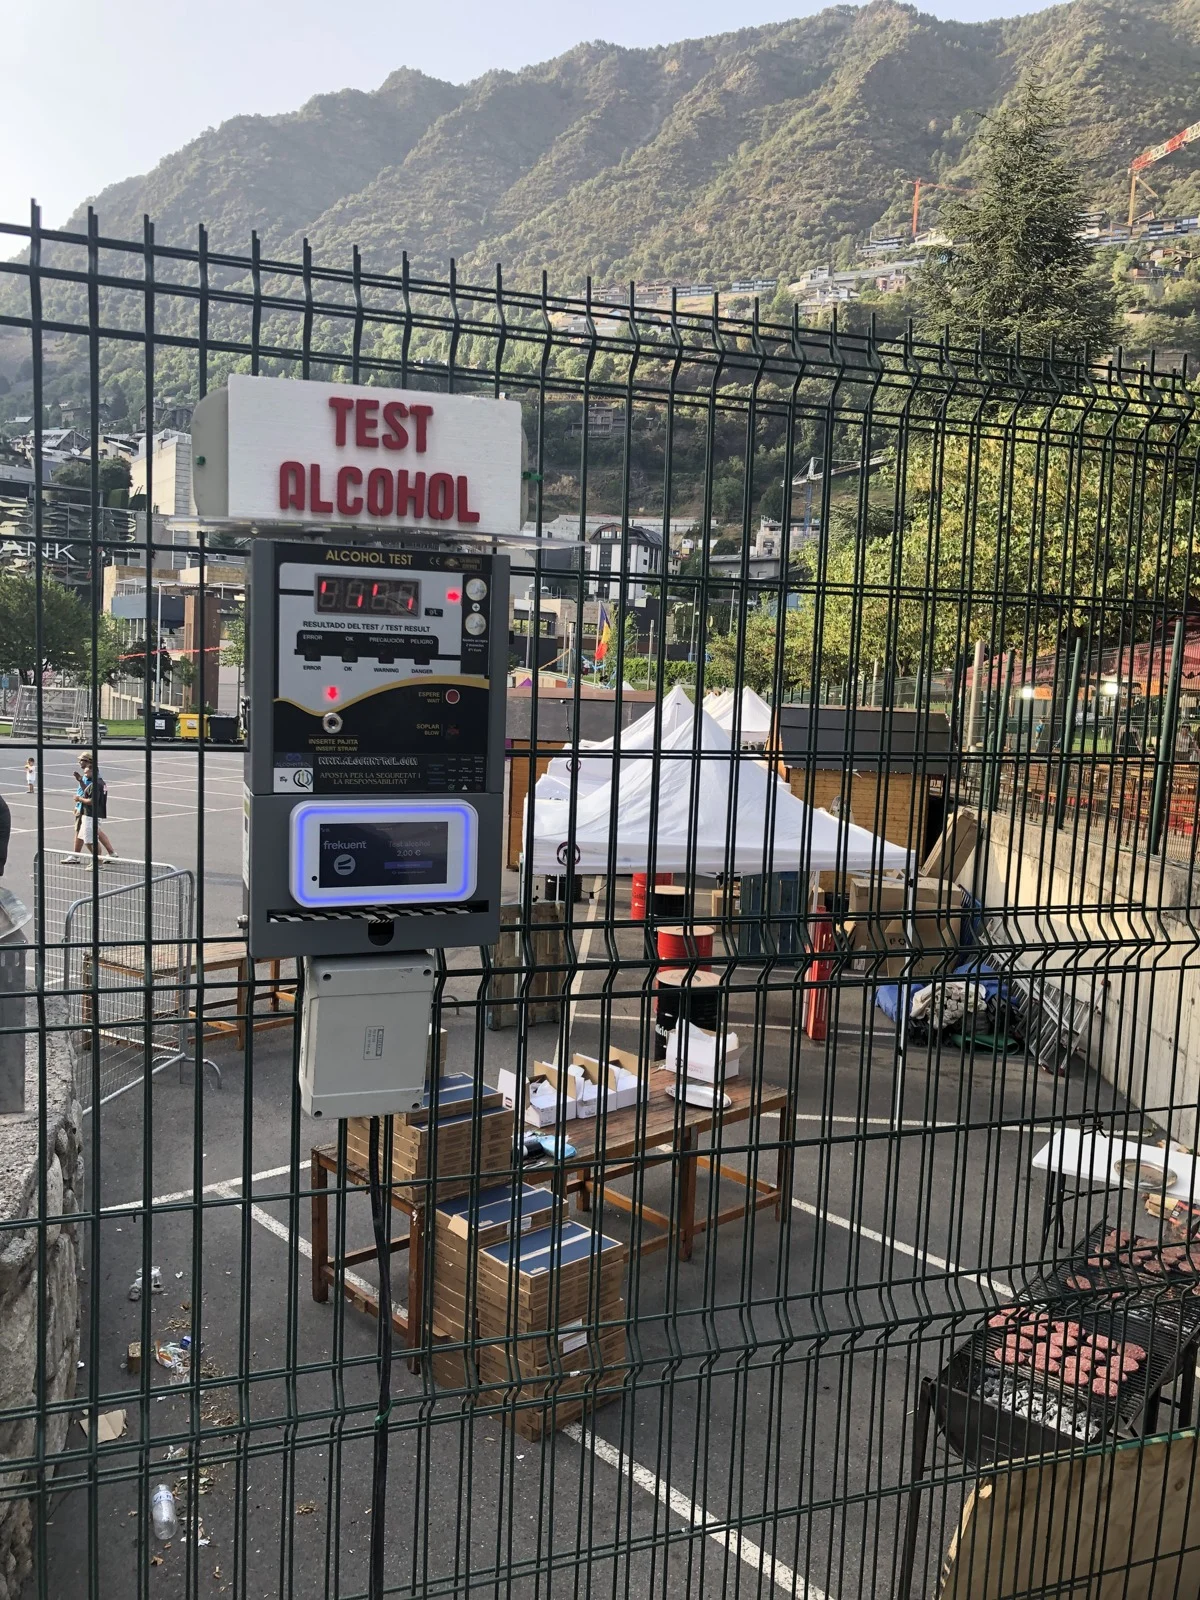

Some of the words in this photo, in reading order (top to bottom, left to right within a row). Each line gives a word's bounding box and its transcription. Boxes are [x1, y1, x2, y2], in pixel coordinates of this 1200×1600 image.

[328, 396, 434, 453] TEST
[279, 461, 481, 524] ALCOHOL
[325, 549, 386, 564] ALCOHOL
[389, 553, 414, 566] TEST
[302, 620, 346, 630] RESULTADO
[347, 621, 360, 630] DEL
[360, 622, 379, 631] TEST
[385, 623, 403, 632] TEST
[403, 624, 431, 633] RESULT
[410, 638, 434, 646] PELIGRO
[308, 738, 335, 746] INSERTE
[336, 738, 359, 746] PAJITA
[319, 771, 348, 780] APOSTA
[349, 772, 364, 780] PER
[365, 772, 374, 780] LA
[375, 772, 417, 780] SEGURETAT
[333, 778, 343, 786] LA
[323, 839, 368, 850] frekuent
